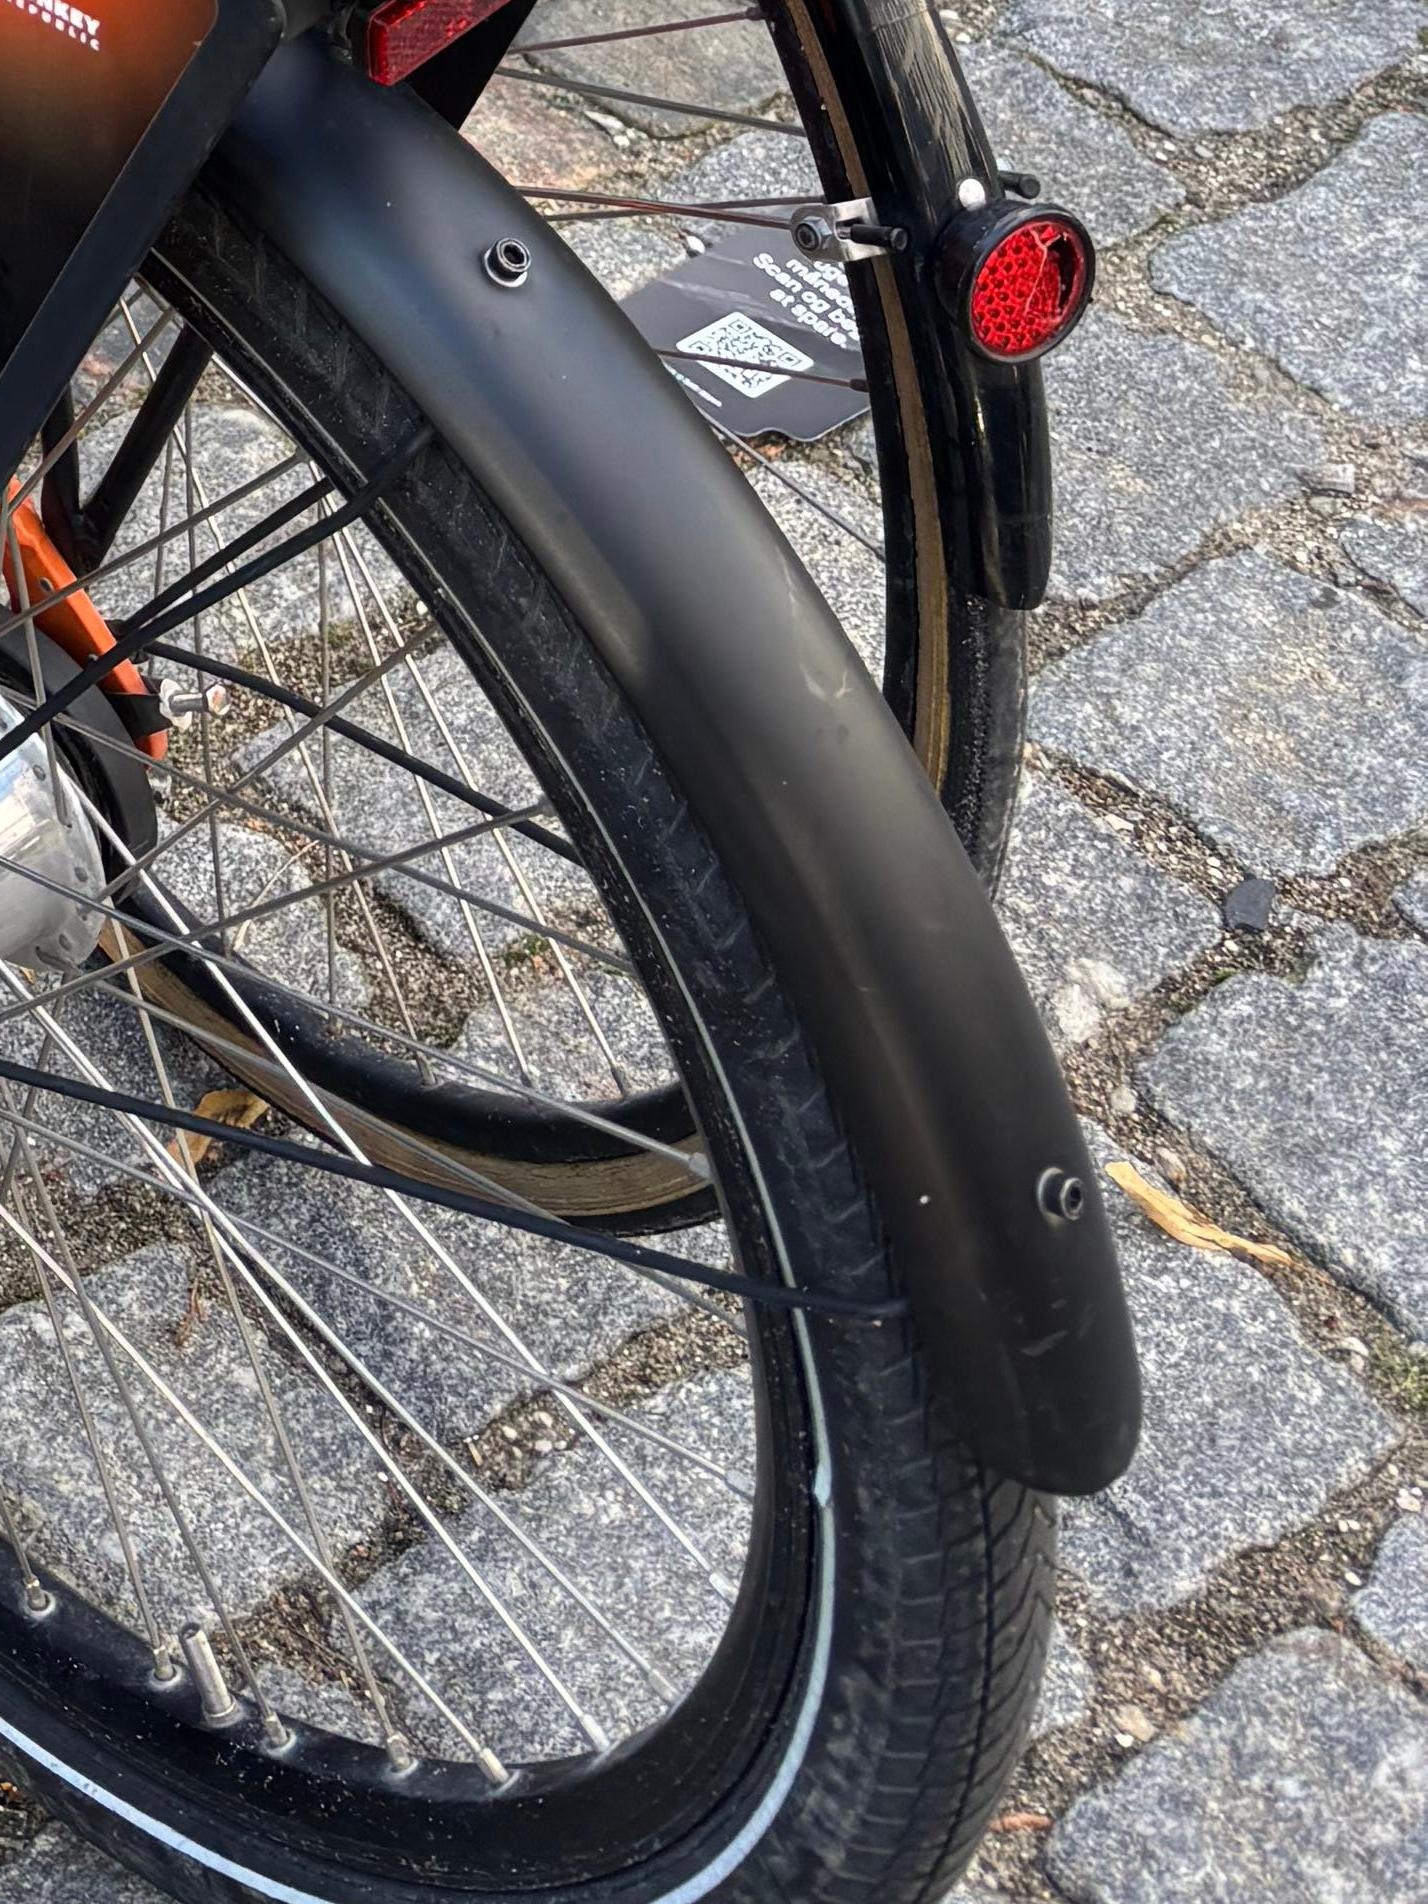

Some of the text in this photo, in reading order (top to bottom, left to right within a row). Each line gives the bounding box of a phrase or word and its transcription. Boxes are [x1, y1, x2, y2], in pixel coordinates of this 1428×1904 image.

[752, 252, 804, 293] Scan
[801, 291, 832, 314] og
[769, 288, 796, 308] at
